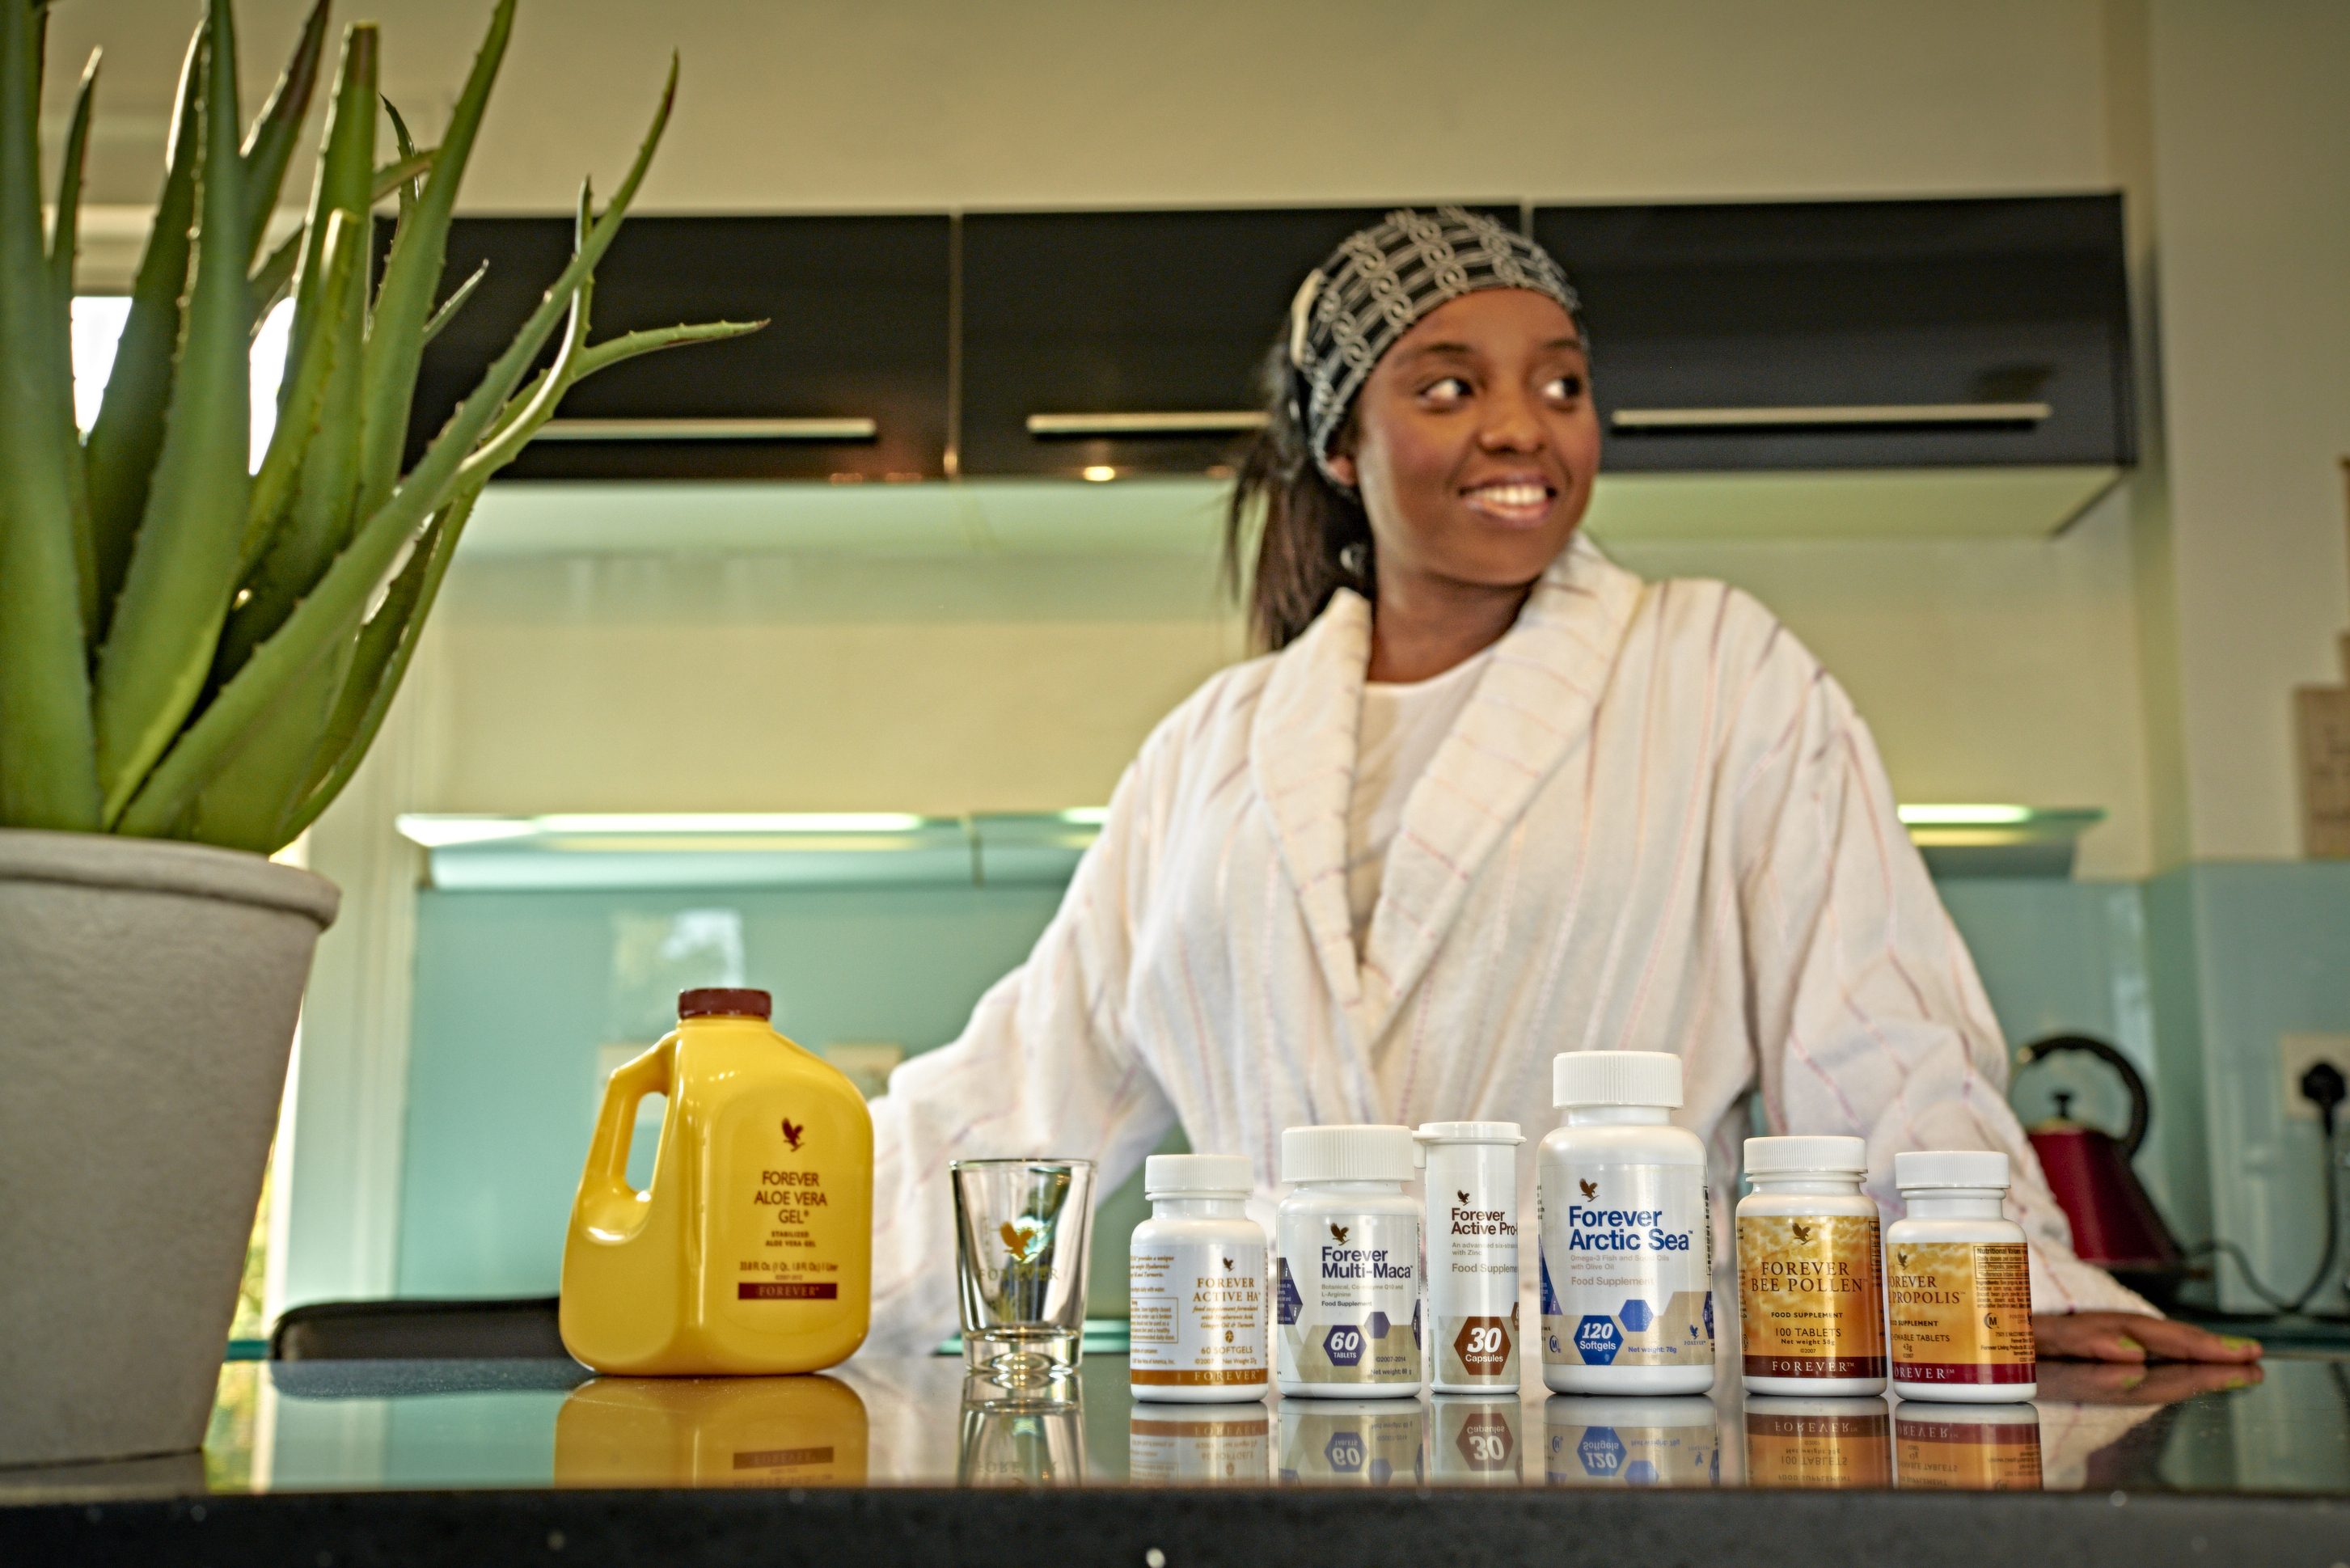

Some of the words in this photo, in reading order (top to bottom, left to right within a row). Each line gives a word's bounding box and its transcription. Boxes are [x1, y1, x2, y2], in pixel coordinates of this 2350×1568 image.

[763, 1171, 819, 1186] FOREVER
[754, 1190, 790, 1205] ALOE
[794, 1192, 827, 1206] VERA
[1452, 1207, 1505, 1221] Forever
[1570, 1206, 1662, 1227] Forever
[1451, 1221, 1496, 1236] Active
[1570, 1228, 1641, 1250] Arctic
[1322, 1246, 1388, 1262] Forever
[979, 1266, 1059, 1281] FOREVER
[1452, 1264, 1477, 1273] Food
[1481, 1264, 1517, 1274] Suppleme
[1762, 1262, 1849, 1275] FOREVER
[1197, 1278, 1254, 1288] FOREVER
[1571, 1277, 1594, 1286] Food
[1596, 1277, 1654, 1287] Supplement
[1752, 1278, 1780, 1292] BEE
[1194, 1292, 1243, 1303] ACTIVE
[1192, 1305, 1206, 1313] food
[1207, 1305, 1236, 1313] supplement
[1582, 1323, 1613, 1339] 120
[1775, 1328, 1791, 1337] 100
[1795, 1328, 1841, 1337] TABLETS
[1330, 1332, 1359, 1350] 60
[1467, 1327, 1502, 1353] 30
[1580, 1341, 1617, 1351] Softgels
[1201, 1346, 1211, 1355] 60
[1215, 1346, 1253, 1355] SOFTGELS
[1642, 1346, 1665, 1354] weight:
[1666, 1346, 1677, 1354] 78g
[1903, 1344, 1913, 1352] 43g
[1465, 1355, 1503, 1363] Capsules
